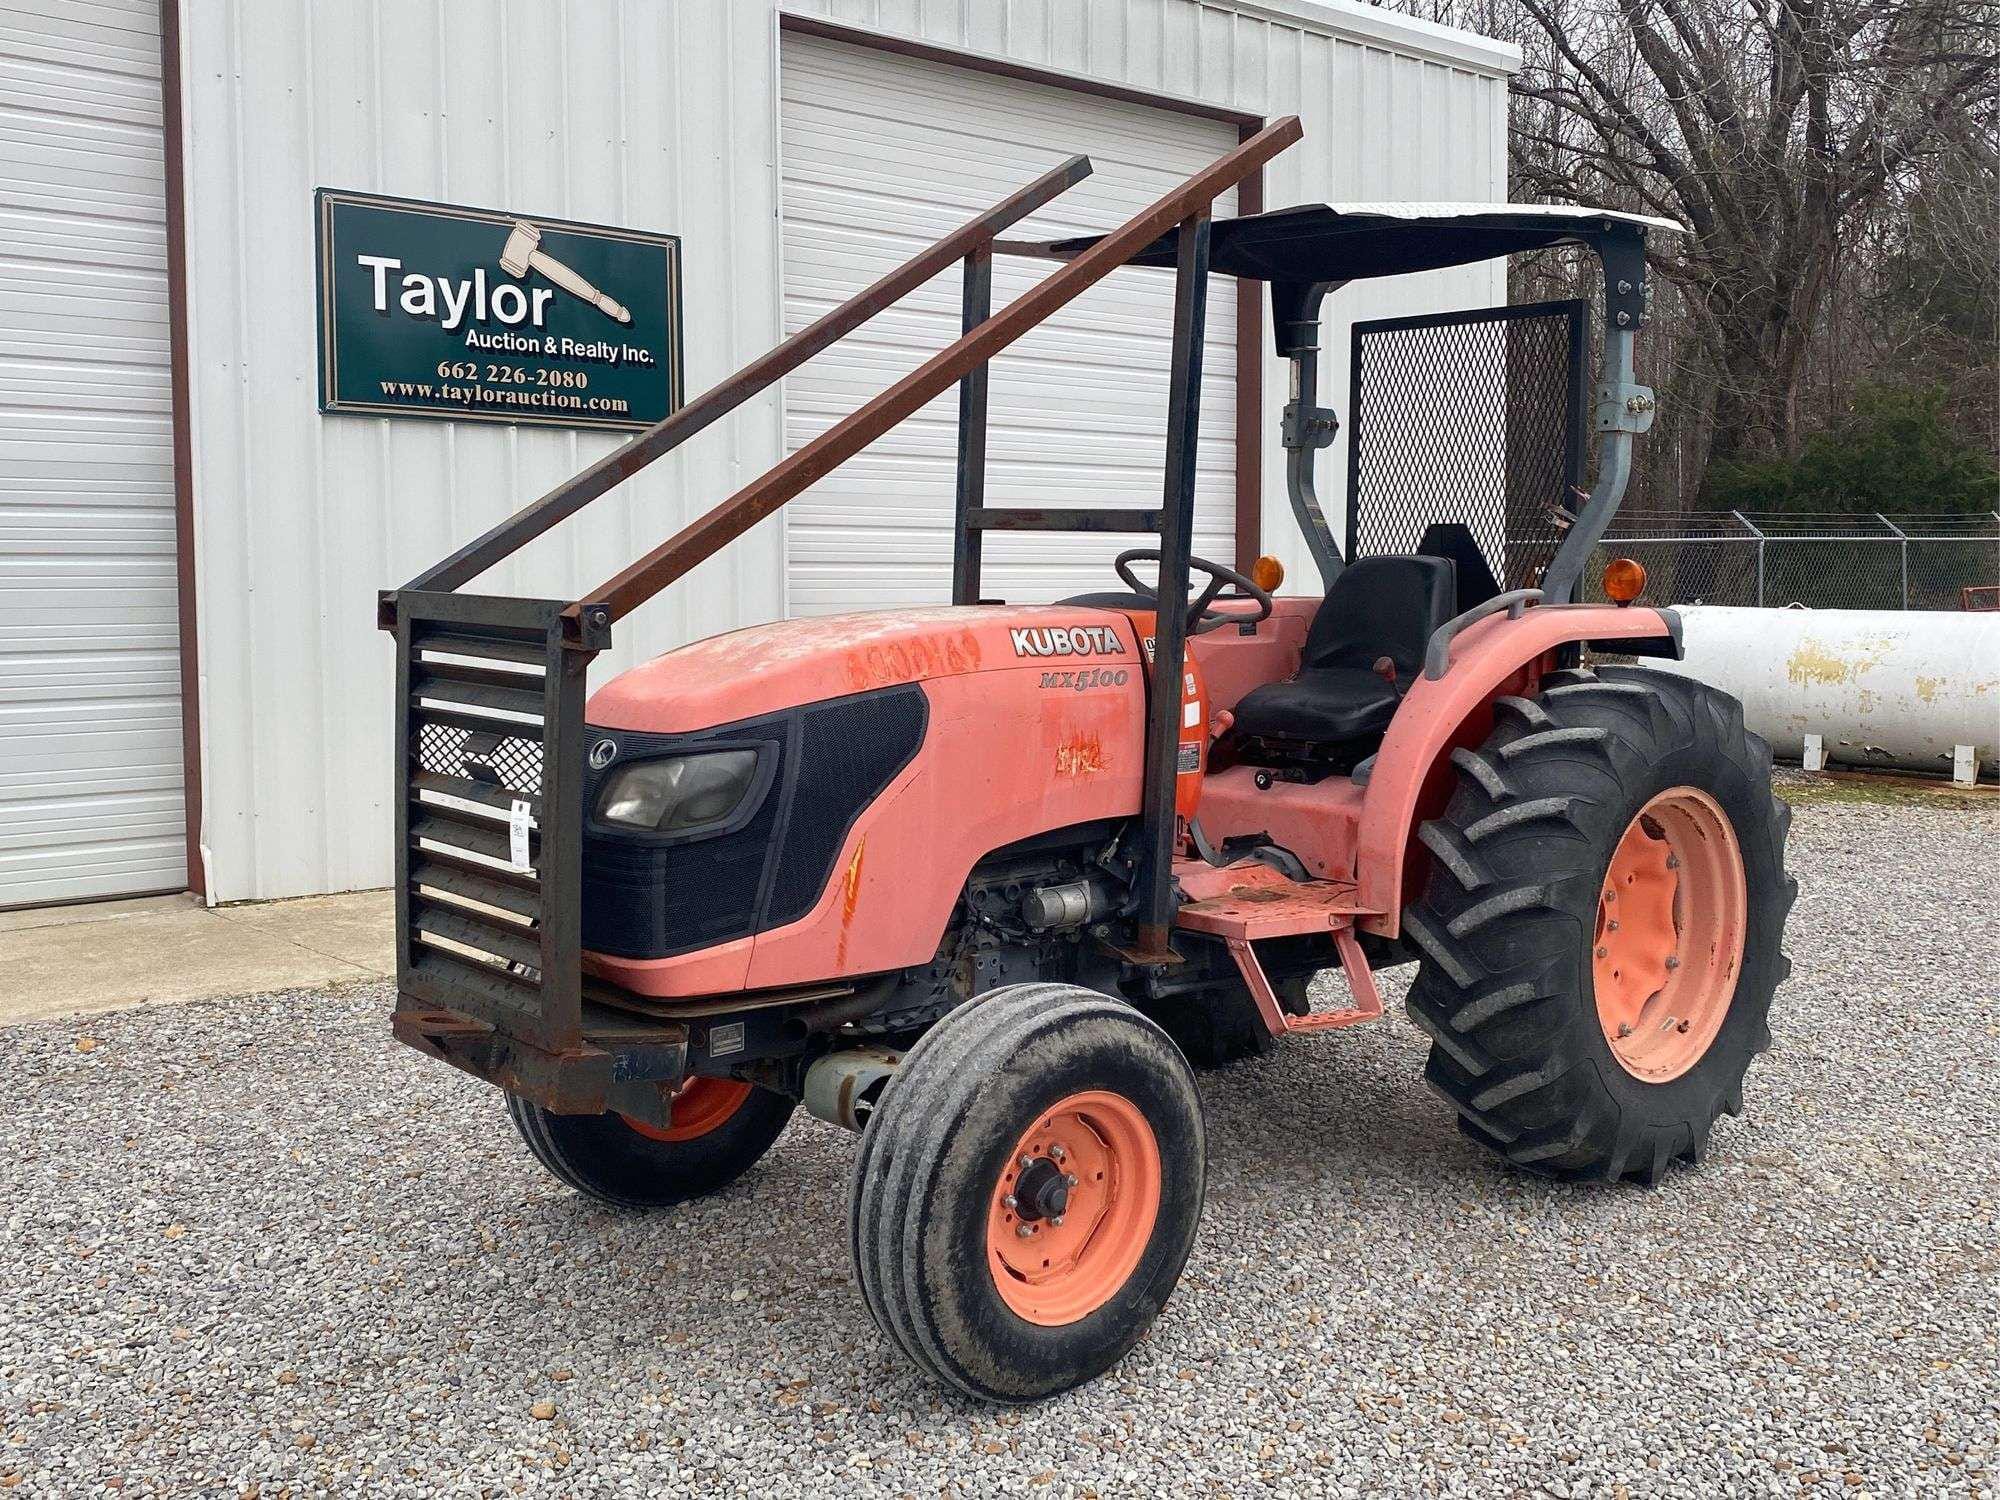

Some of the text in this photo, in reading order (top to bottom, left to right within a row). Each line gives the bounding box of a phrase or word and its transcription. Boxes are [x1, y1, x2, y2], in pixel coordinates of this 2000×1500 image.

[357, 254, 553, 329] Taylor
[465, 328, 654, 363] Auction & Realty Inc.
[437, 361, 588, 389] 662 226-2080
[380, 380, 629, 412] www.taylorauction.com
[1010, 625, 1126, 657] KUBOTA
[1039, 669, 1129, 692] MX5100
